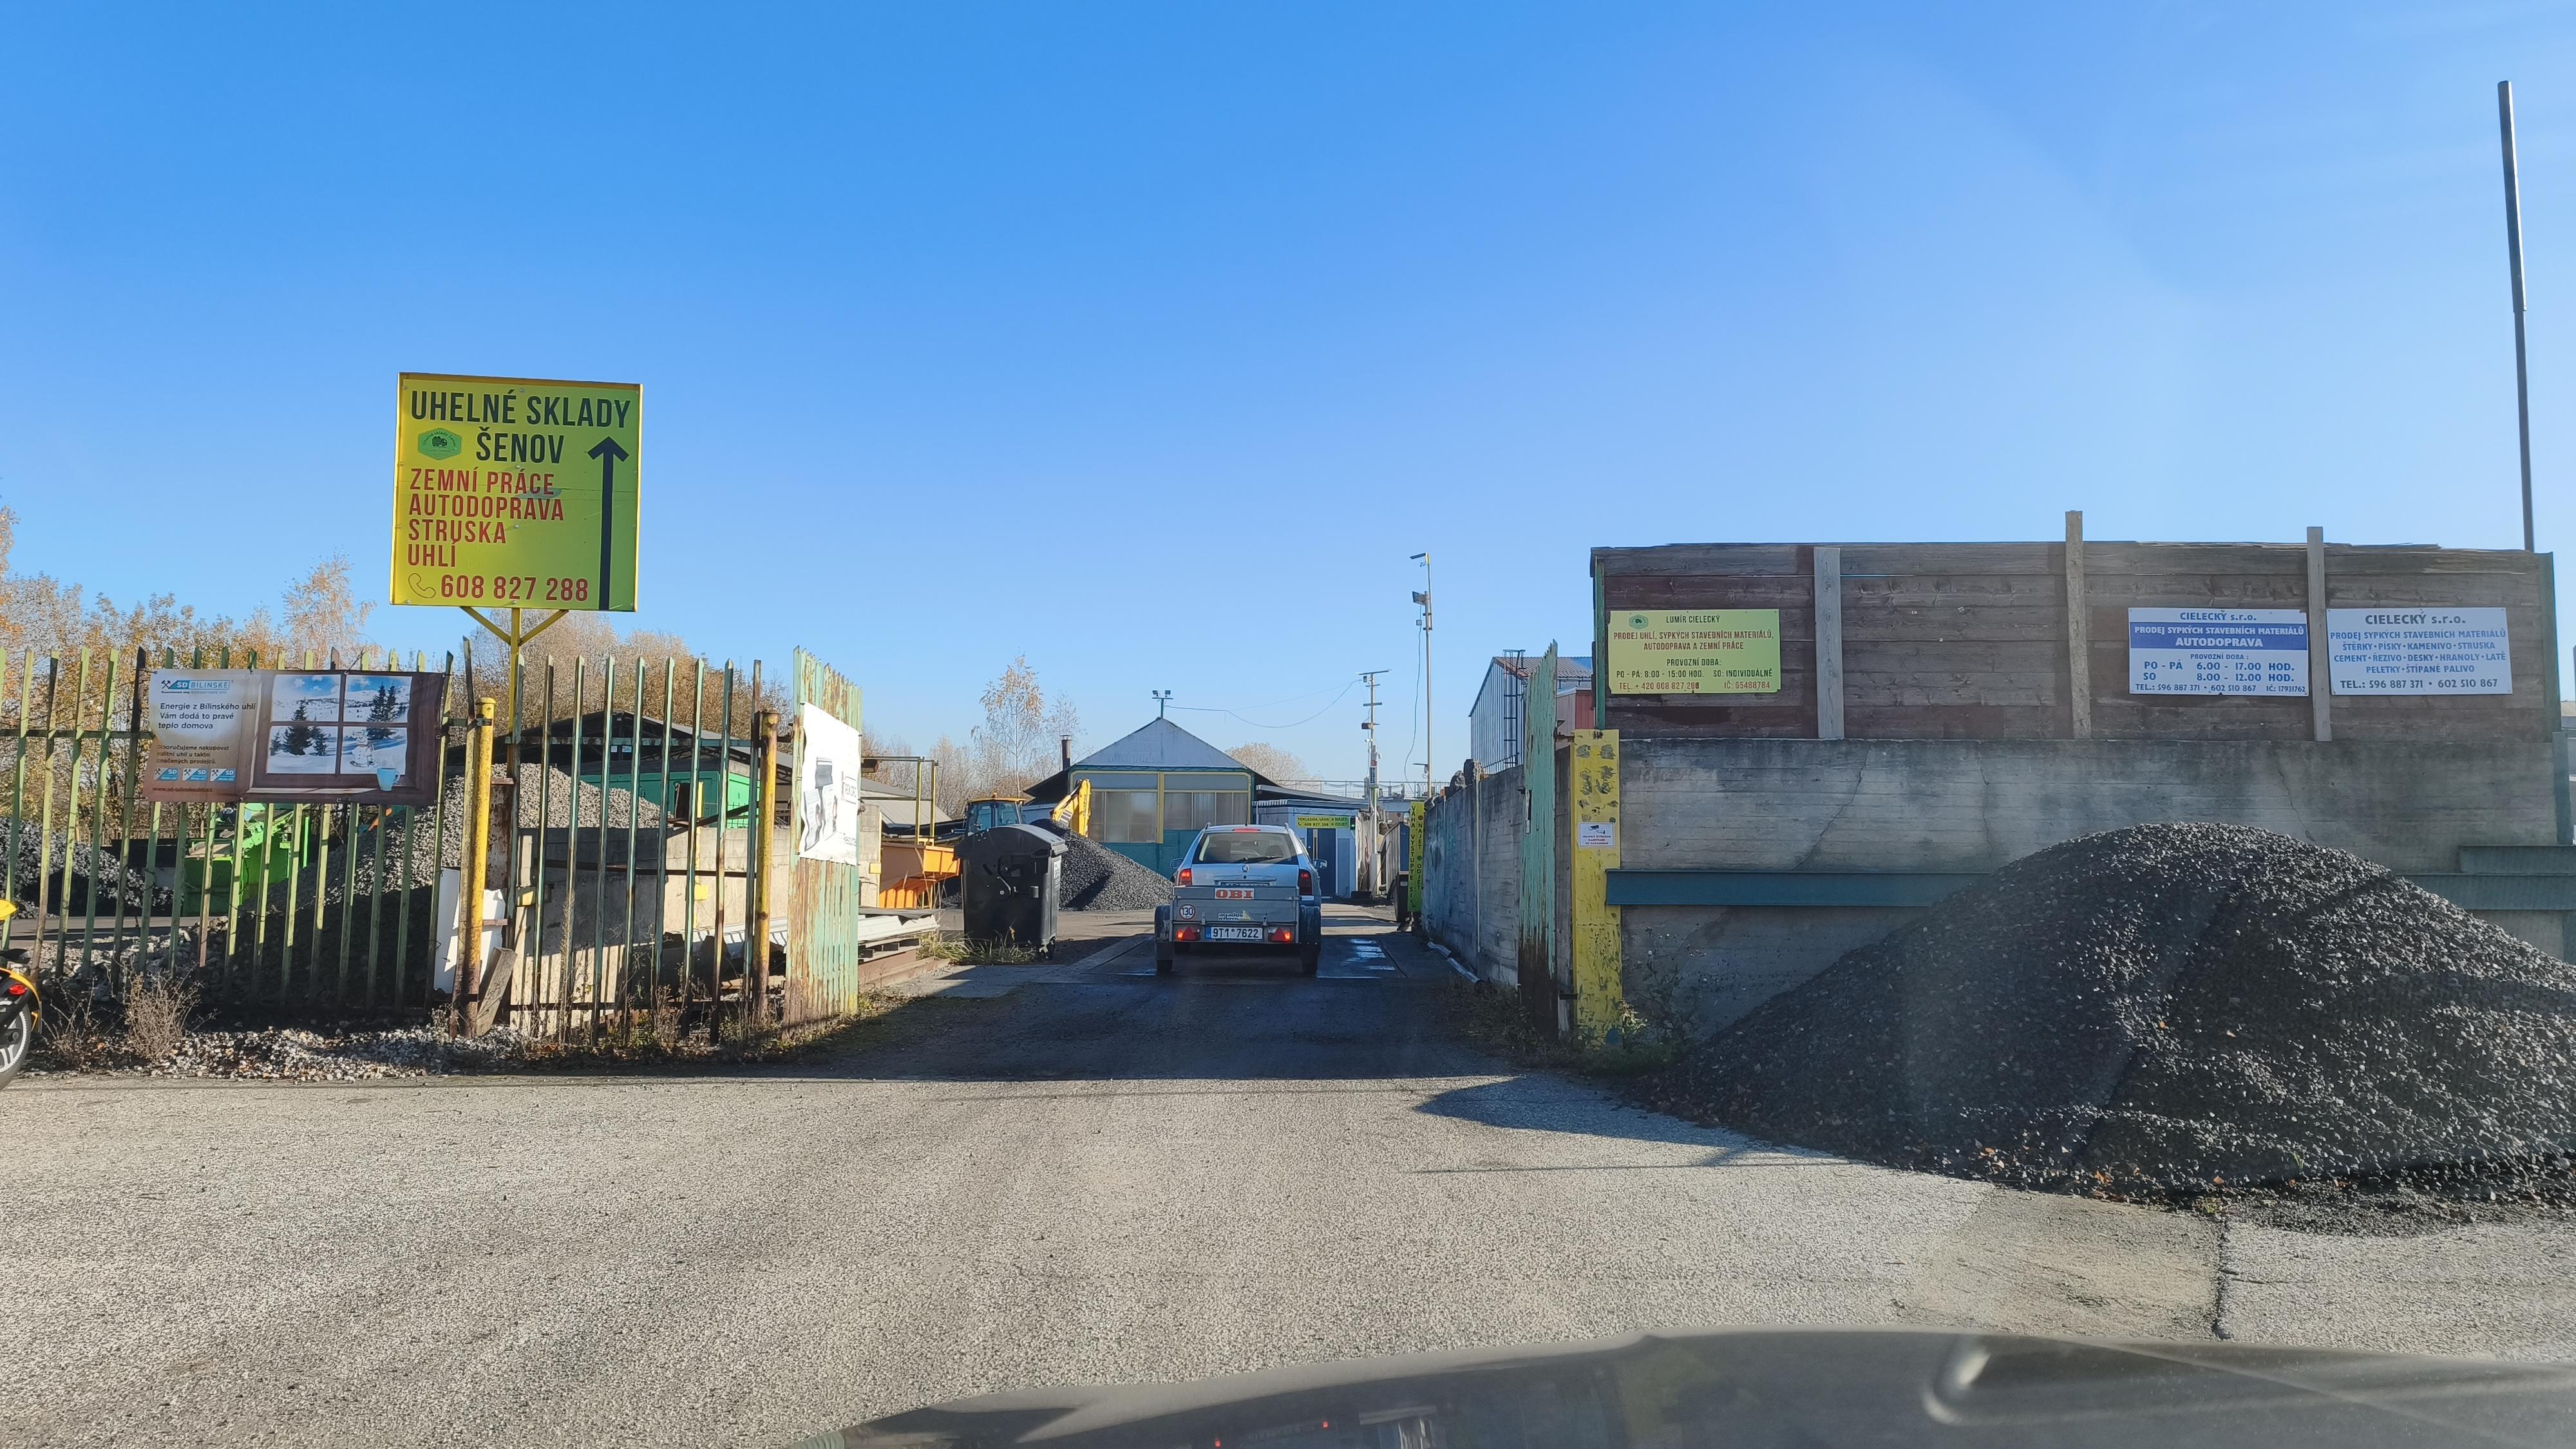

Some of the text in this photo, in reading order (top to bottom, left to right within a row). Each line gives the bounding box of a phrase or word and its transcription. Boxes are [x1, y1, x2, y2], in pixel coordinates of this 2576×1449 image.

[411, 389, 631, 428] UHELNÉ SKLADY
[476, 426, 564, 464] ŠENOV
[410, 466, 554, 495] ZEMNÍ PRÁCE
[408, 493, 564, 521] AUTODOPRAVA
[408, 518, 506, 544] STRUSKA
[408, 542, 456, 567] UHLÍ
[441, 574, 588, 601] 608 827 288
[1667, 614, 1720, 623] LUMÍR CIELECKÝ
[2180, 610, 2227, 620] CIELECKÝ
[2365, 611, 2466, 624] CIELECKÝ s.r.o.
[1640, 630, 1657, 640] UHLÍ,
[1659, 630, 1689, 639] SYPKÝCH
[1692, 630, 1732, 639] STAVEBNÍCH
[1734, 629, 1774, 639] MATERIÁLŮ,
[2134, 625, 2304, 635] PRODEJ SYPKÝCH STAVEBNÍCH MATERIÁLŮ
[2330, 627, 2506, 641] PRODEJ SYPKÝCH STAVEBNÍCH MATERIÁLŮ
[1700, 641, 1720, 650] ZEMNÍ
[1723, 641, 1744, 650] PRÁCE
[2175, 638, 2263, 647] AUTODOPRAVA
[2343, 641, 2372, 650] ŠTĚRKY
[2378, 641, 2401, 650] PÍSKY
[2372, 652, 2401, 661] ŘEZIVO
[2486, 651, 2506, 660] LATĚ
[1667, 658, 1700, 666] PROVOZNÍ
[2169, 659, 2183, 670] PÁ
[1726, 668, 1772, 677] INDIVIDUÁLNĚ
[2406, 663, 2441, 673] ŠTÍPANÉ
[2340, 680, 2365, 688] TEL.:
[2369, 680, 2387, 688] 596
[2390, 680, 2407, 688] 887
[2438, 679, 2457, 688] 602
[2480, 679, 2497, 687] 867
[213, 712, 234, 721] pravé
[1216, 889, 1253, 898] OBI
[1182, 907, 1193, 916] 130
[1213, 928, 1259, 938] 9T1 7622
